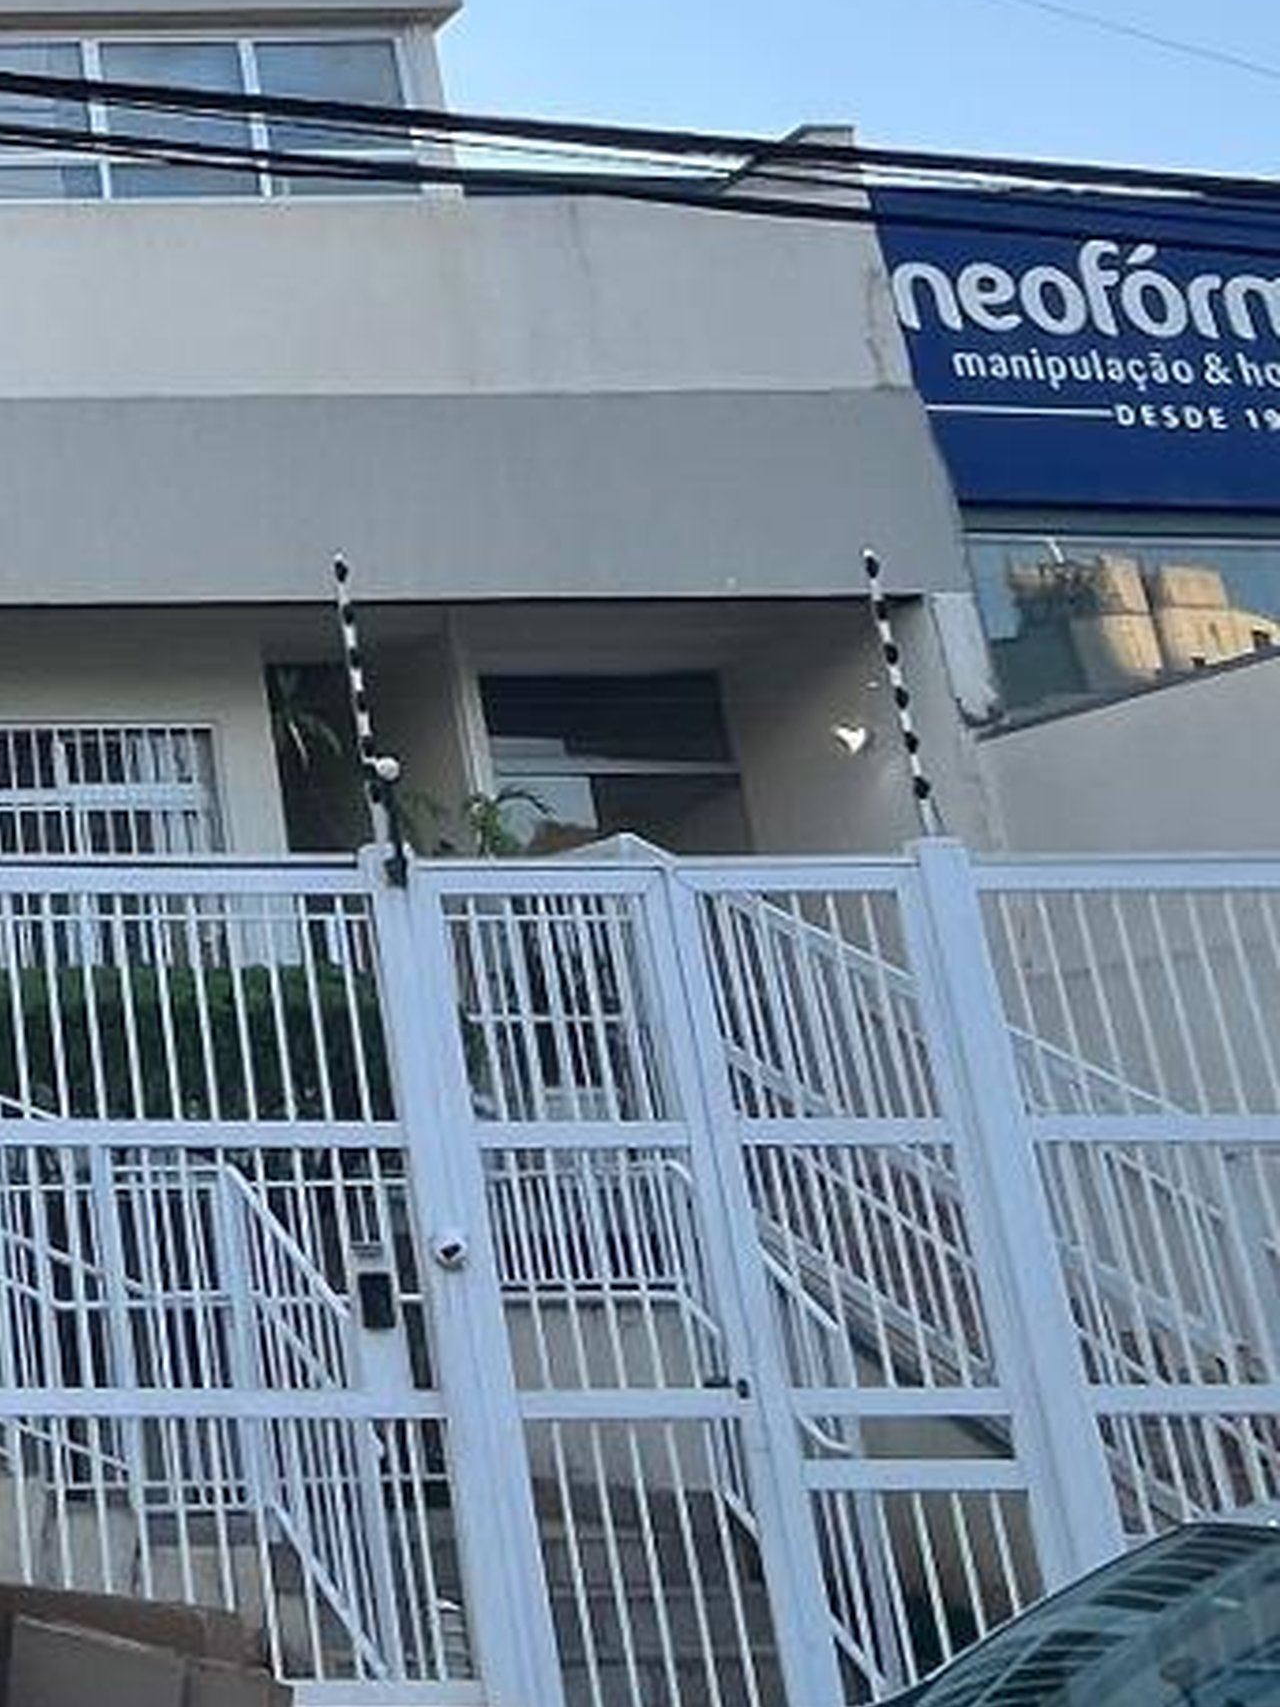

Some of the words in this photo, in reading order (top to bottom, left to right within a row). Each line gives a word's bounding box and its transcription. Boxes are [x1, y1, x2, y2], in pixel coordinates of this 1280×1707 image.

[951, 347, 1194, 393] manipulação
[1204, 352, 1233, 385] &
[1114, 403, 1228, 431] DESDE
